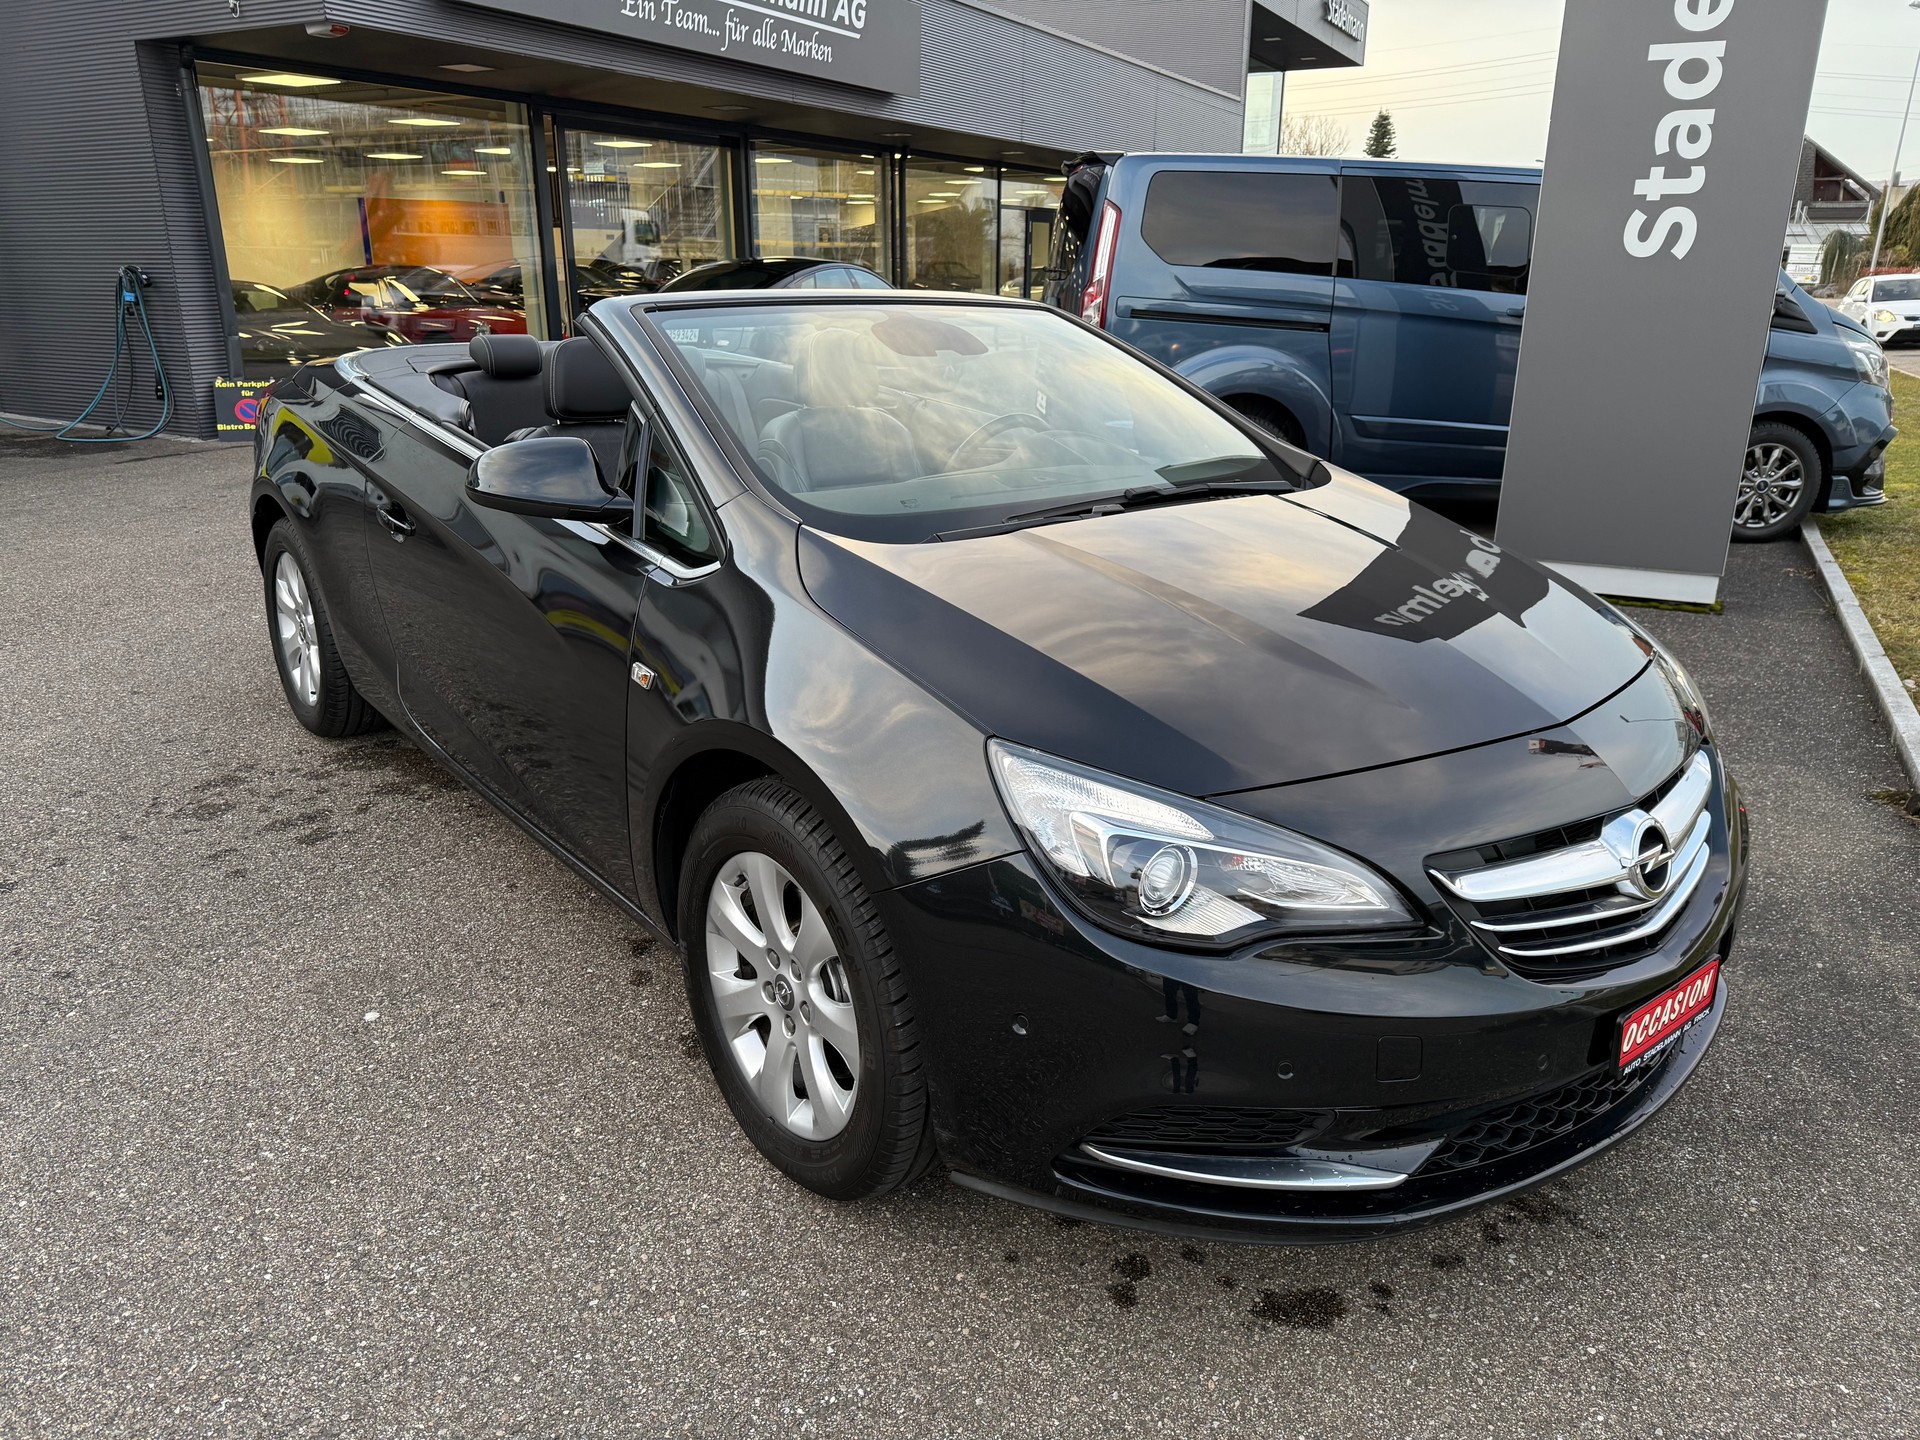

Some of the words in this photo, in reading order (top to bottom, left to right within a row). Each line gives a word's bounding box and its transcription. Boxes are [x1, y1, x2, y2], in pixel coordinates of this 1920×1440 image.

[832, 0, 867, 29] AG
[620, 0, 656, 21] Ein
[720, 8, 749, 51] für
[752, 18, 777, 49] alle
[780, 29, 833, 63] Marken
[215, 380, 235, 388] Kein
[1622, 969, 1714, 1053] OCCASION
[1623, 1058, 1641, 1076] AUTO
